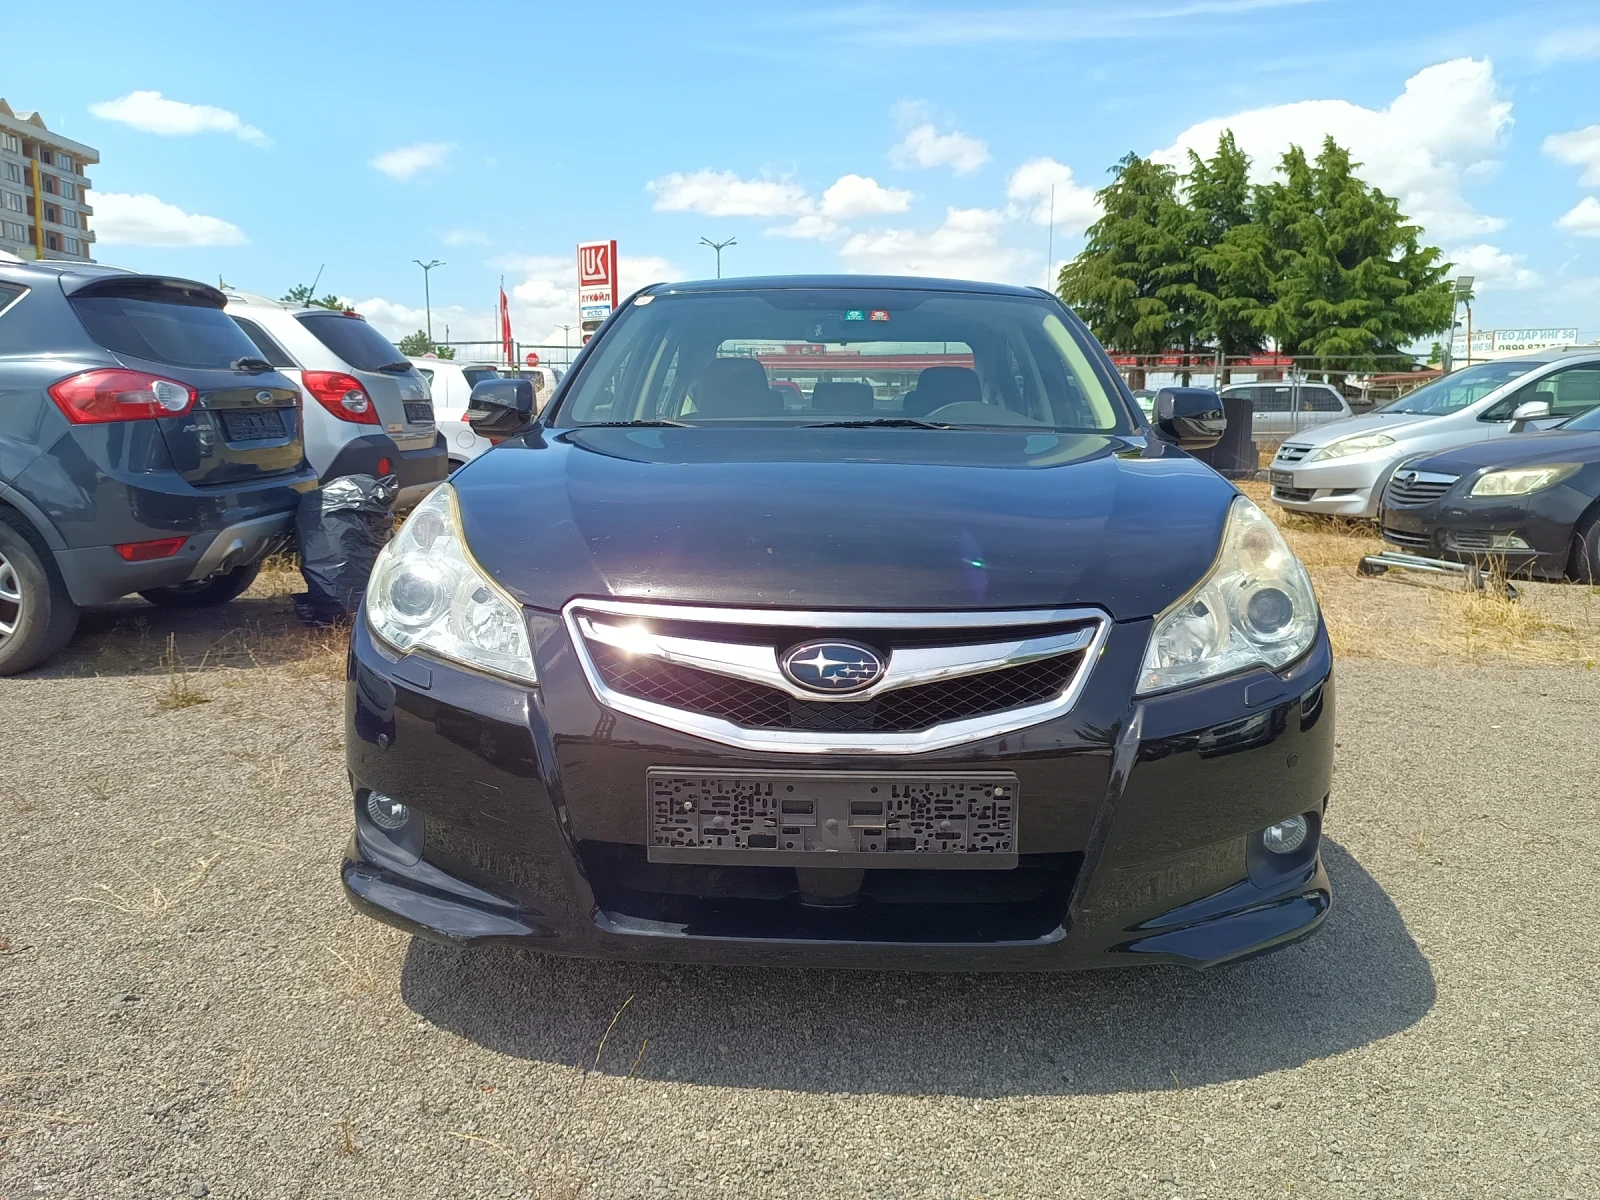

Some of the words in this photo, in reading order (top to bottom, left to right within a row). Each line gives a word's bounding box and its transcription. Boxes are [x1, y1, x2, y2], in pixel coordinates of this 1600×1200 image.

[581, 292, 610, 303] ЛУКОЙЛ
[1496, 331, 1515, 341] ТЕО
[1516, 331, 1538, 342] ДАР
[1540, 330, 1561, 340] ИНГ
[1562, 330, 1575, 339] 56
